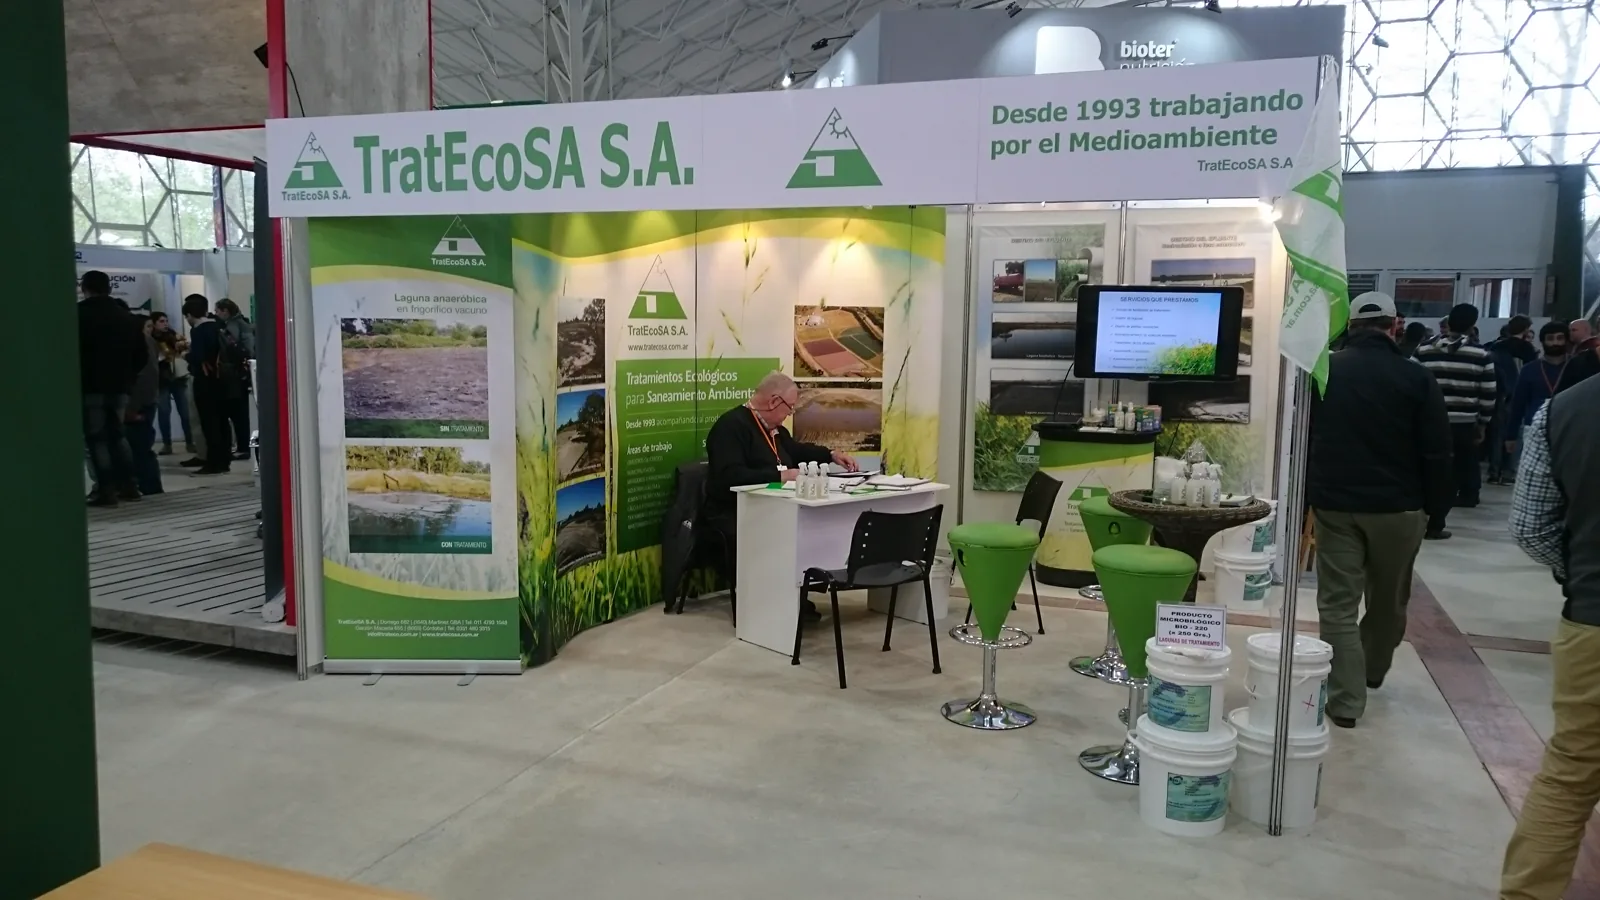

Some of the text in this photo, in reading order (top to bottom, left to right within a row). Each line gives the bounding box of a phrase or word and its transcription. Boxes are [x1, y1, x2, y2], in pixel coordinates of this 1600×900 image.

[1120, 40, 1175, 58] bioter
[992, 89, 1304, 125] Desde 1993 trabajando
[991, 124, 1278, 160] por el Medioambiente
[354, 120, 694, 194] TratEcoSA S.A.
[1197, 158, 1267, 172] TratEcoSA
[281, 189, 351, 201] TratEcoSA S.A.
[431, 257, 487, 266] TratEcoSA S.A.
[394, 293, 487, 304] Laguna anaeróbica
[628, 325, 688, 336] TratEcoSA S.A.
[628, 343, 688, 351] www.tratecosa.com.ar
[626, 369, 738, 385] Tratamientos Ecológicos
[625, 394, 645, 408] para
[647, 389, 707, 403] Saneamiento
[450, 425, 484, 433] TRATAMIENTO
[625, 420, 641, 430] Desde
[642, 418, 656, 428] 1993
[626, 441, 673, 455] Áreas de trabajo
[453, 541, 487, 549] TRATAMIENTO
[1171, 611, 1213, 619] PRODUCTO
[1188, 639, 1220, 647] TRATAMIENTO
